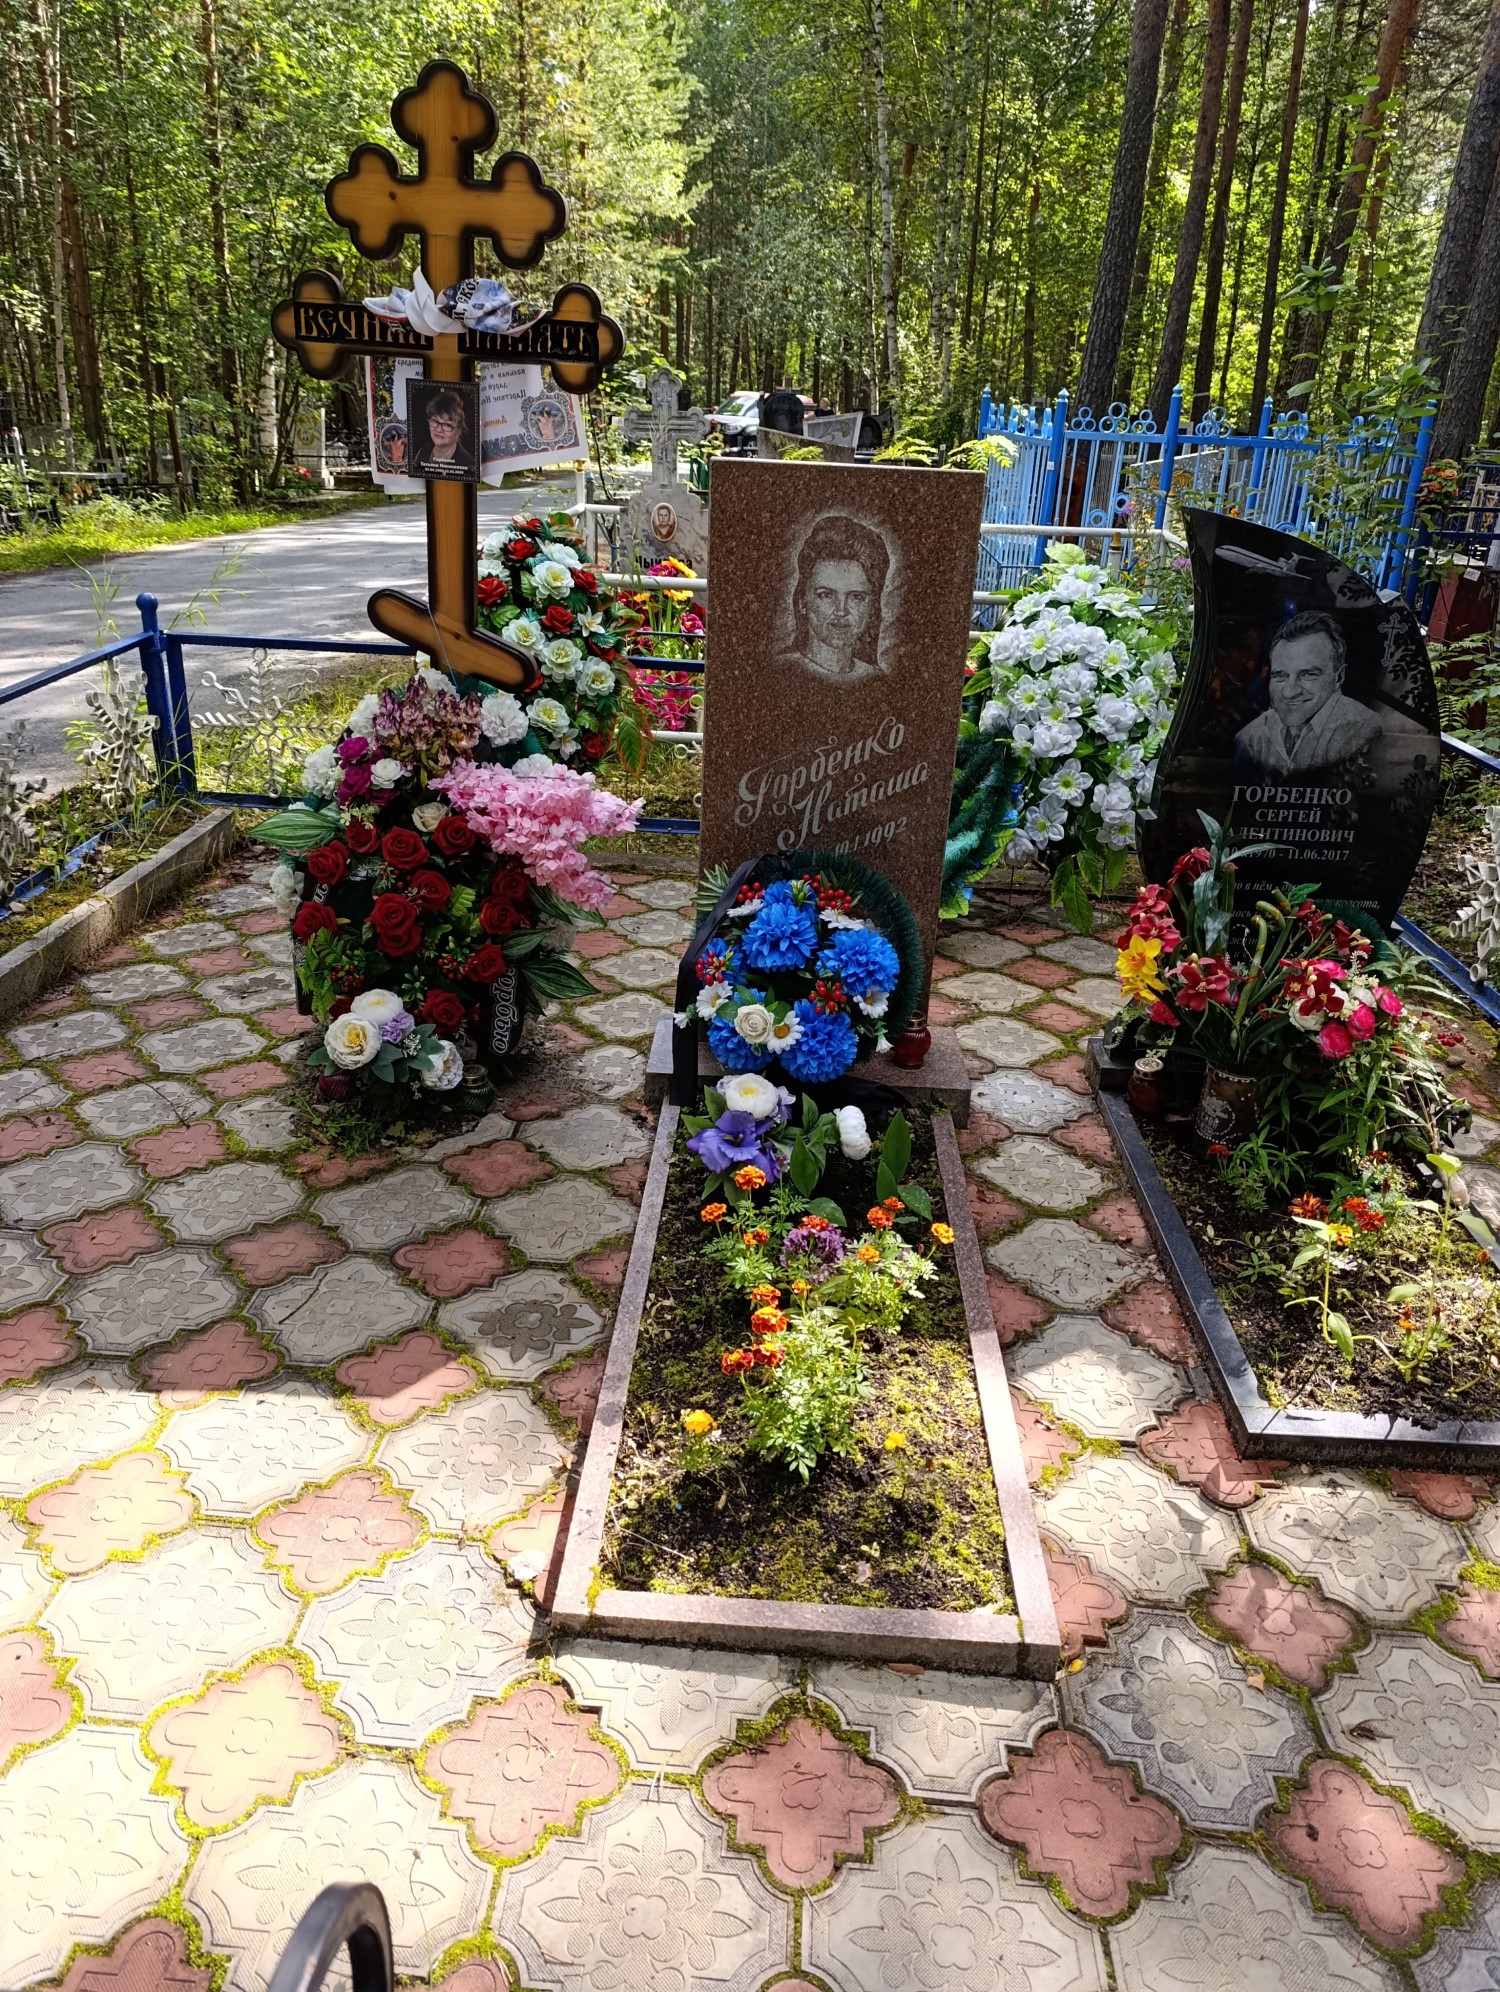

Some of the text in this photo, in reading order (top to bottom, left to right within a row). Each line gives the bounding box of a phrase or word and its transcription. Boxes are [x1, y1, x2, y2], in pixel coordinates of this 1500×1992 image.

[734, 716, 905, 827] Горбенко
[1231, 785, 1352, 805] ГОРБЕНКО
[773, 762, 929, 851] Наташа
[1255, 807, 1322, 823] СЕРГЕЙ
[1221, 826, 1356, 843] АЛЕНТИНОВИЧ
[1288, 848, 1350, 861] 11.06.2017
